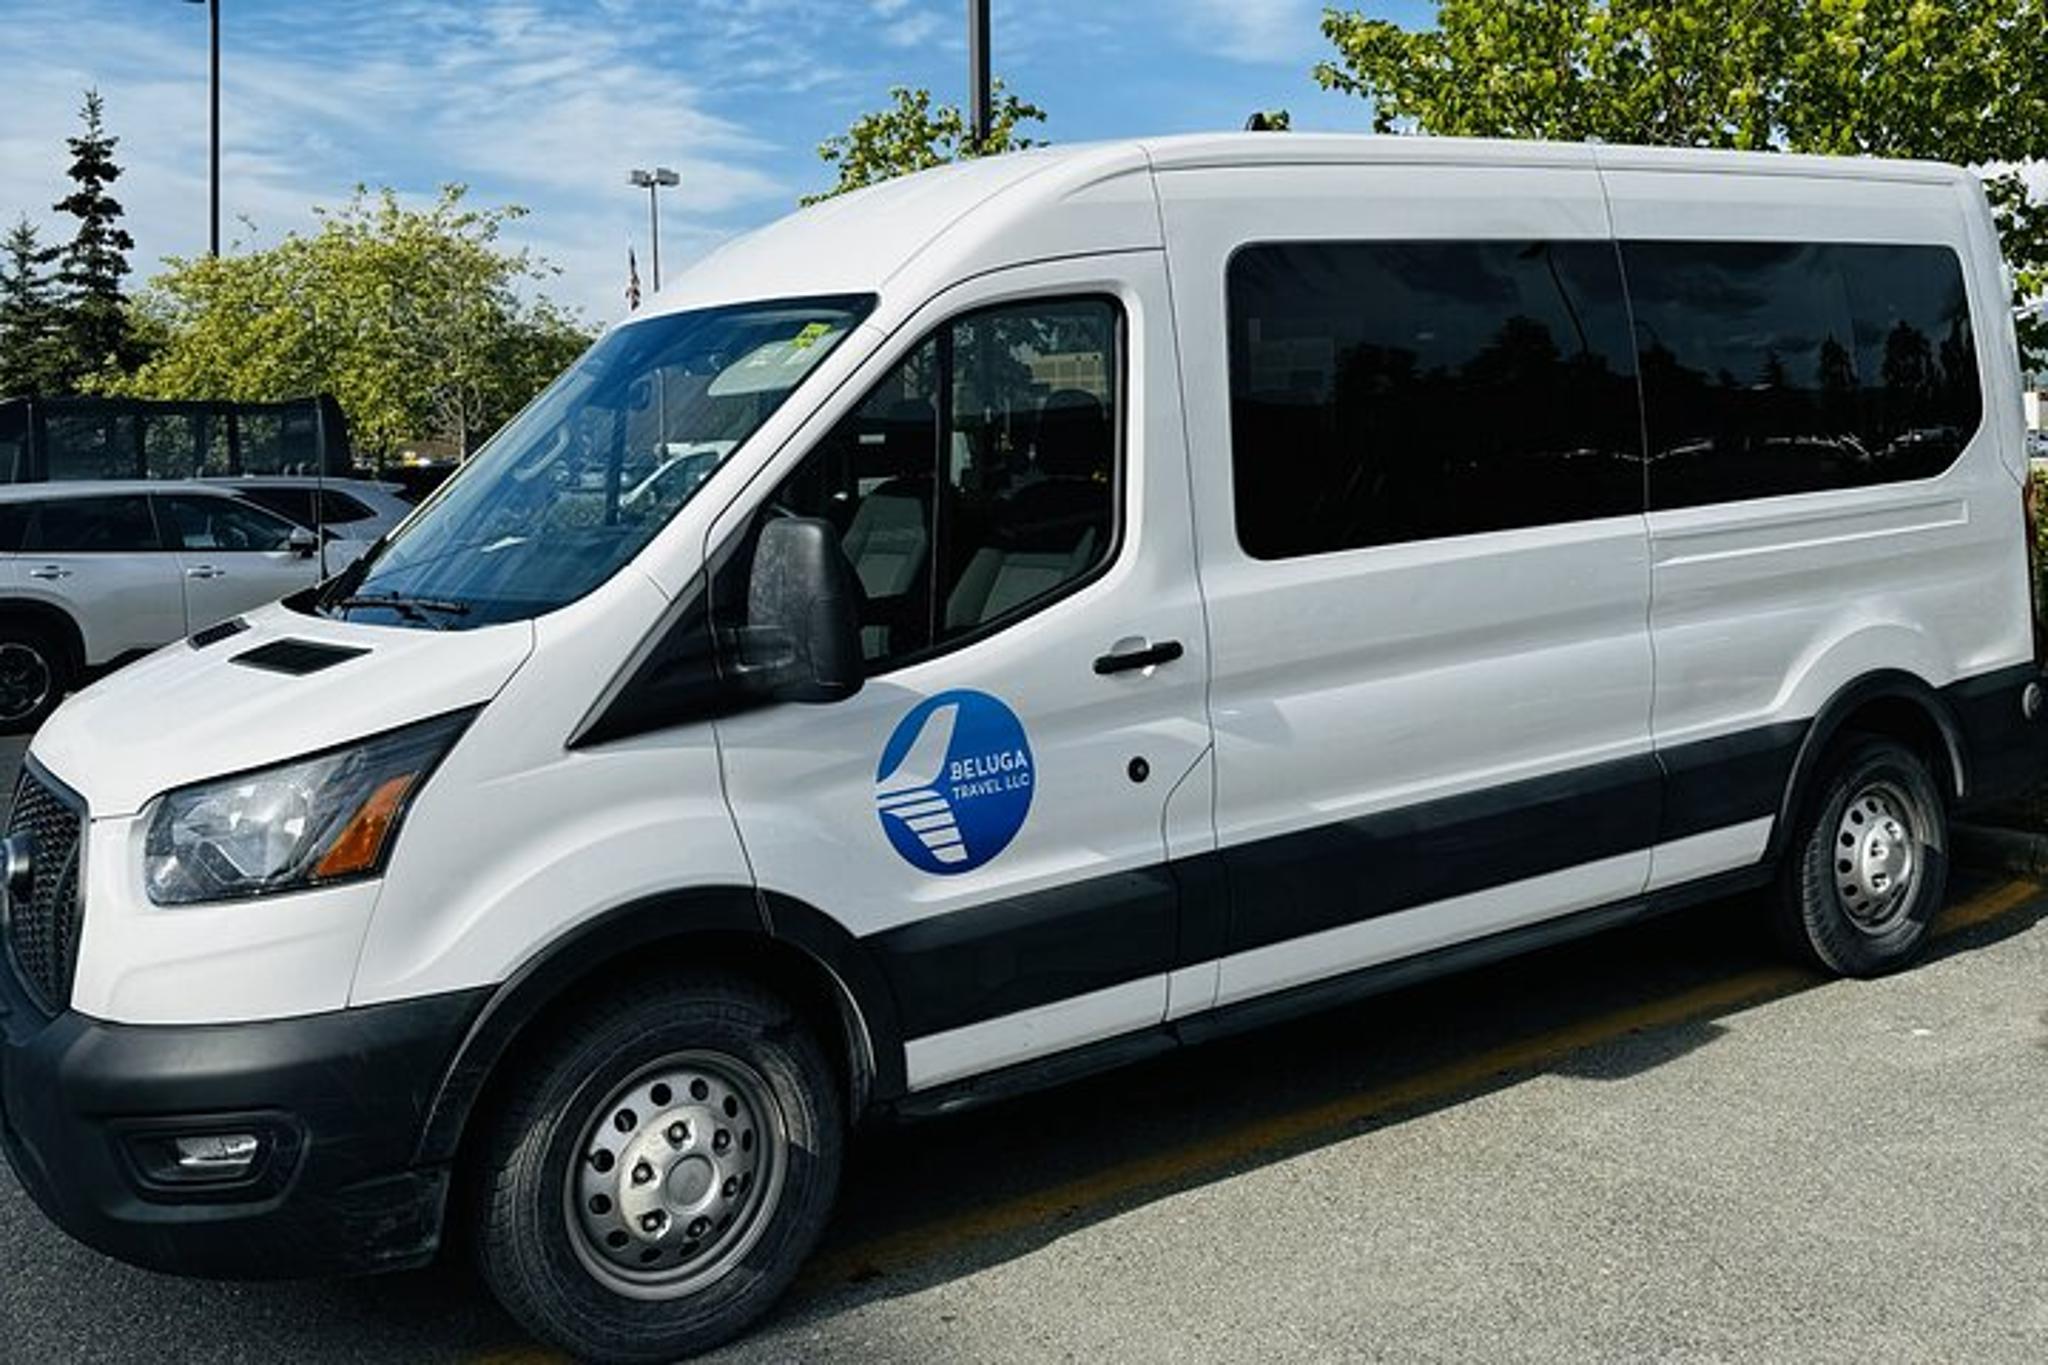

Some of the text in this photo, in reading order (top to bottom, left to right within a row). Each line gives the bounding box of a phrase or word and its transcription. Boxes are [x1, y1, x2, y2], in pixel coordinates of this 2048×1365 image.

[950, 749, 1028, 780] BELUGA
[952, 772, 1030, 800] TRAVEL LLC
